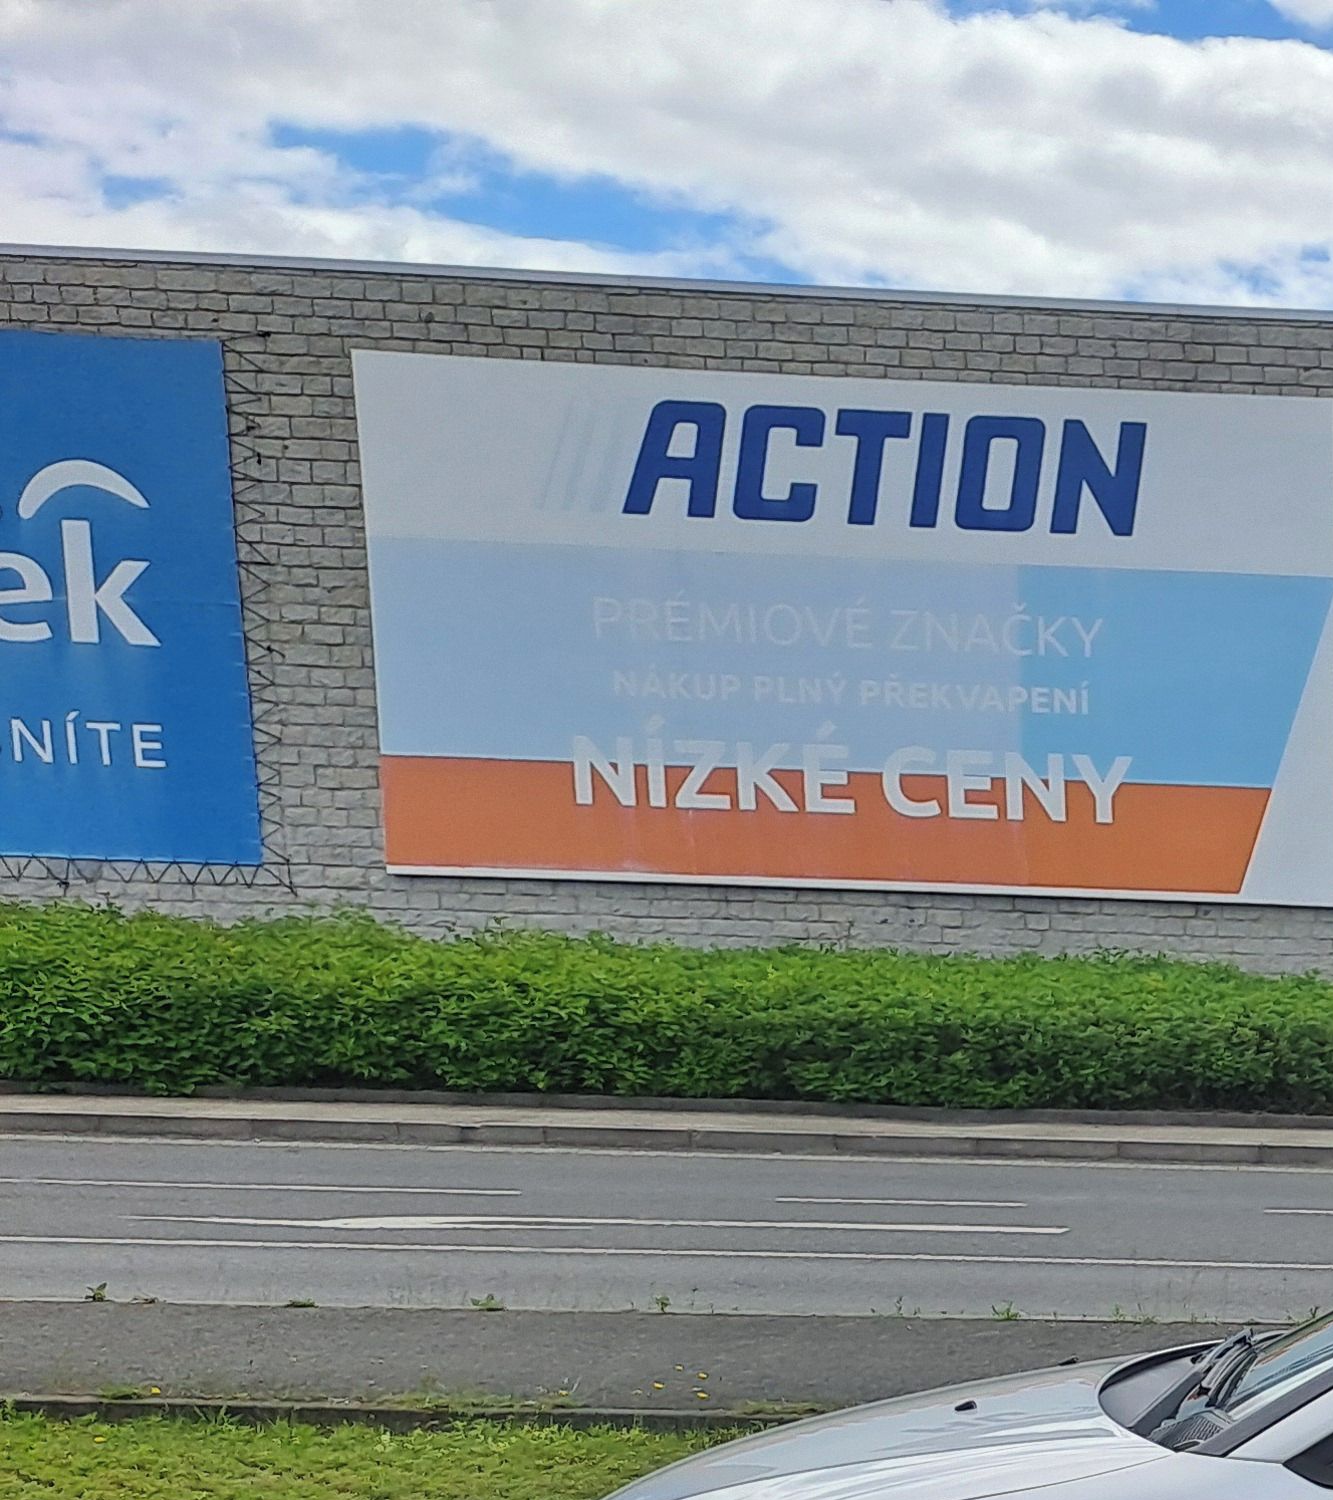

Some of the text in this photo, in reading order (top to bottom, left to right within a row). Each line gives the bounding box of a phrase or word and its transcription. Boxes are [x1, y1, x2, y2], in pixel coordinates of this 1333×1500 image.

[622, 399, 1148, 537] ACTION
[592, 588, 1103, 658] PRÉMIOVÉ ZNAČKY
[613, 663, 1089, 715] NÁKUP PLNÝ PŘEKVAPENÍ
[572, 714, 1133, 824] NÍZKÉ CENY
